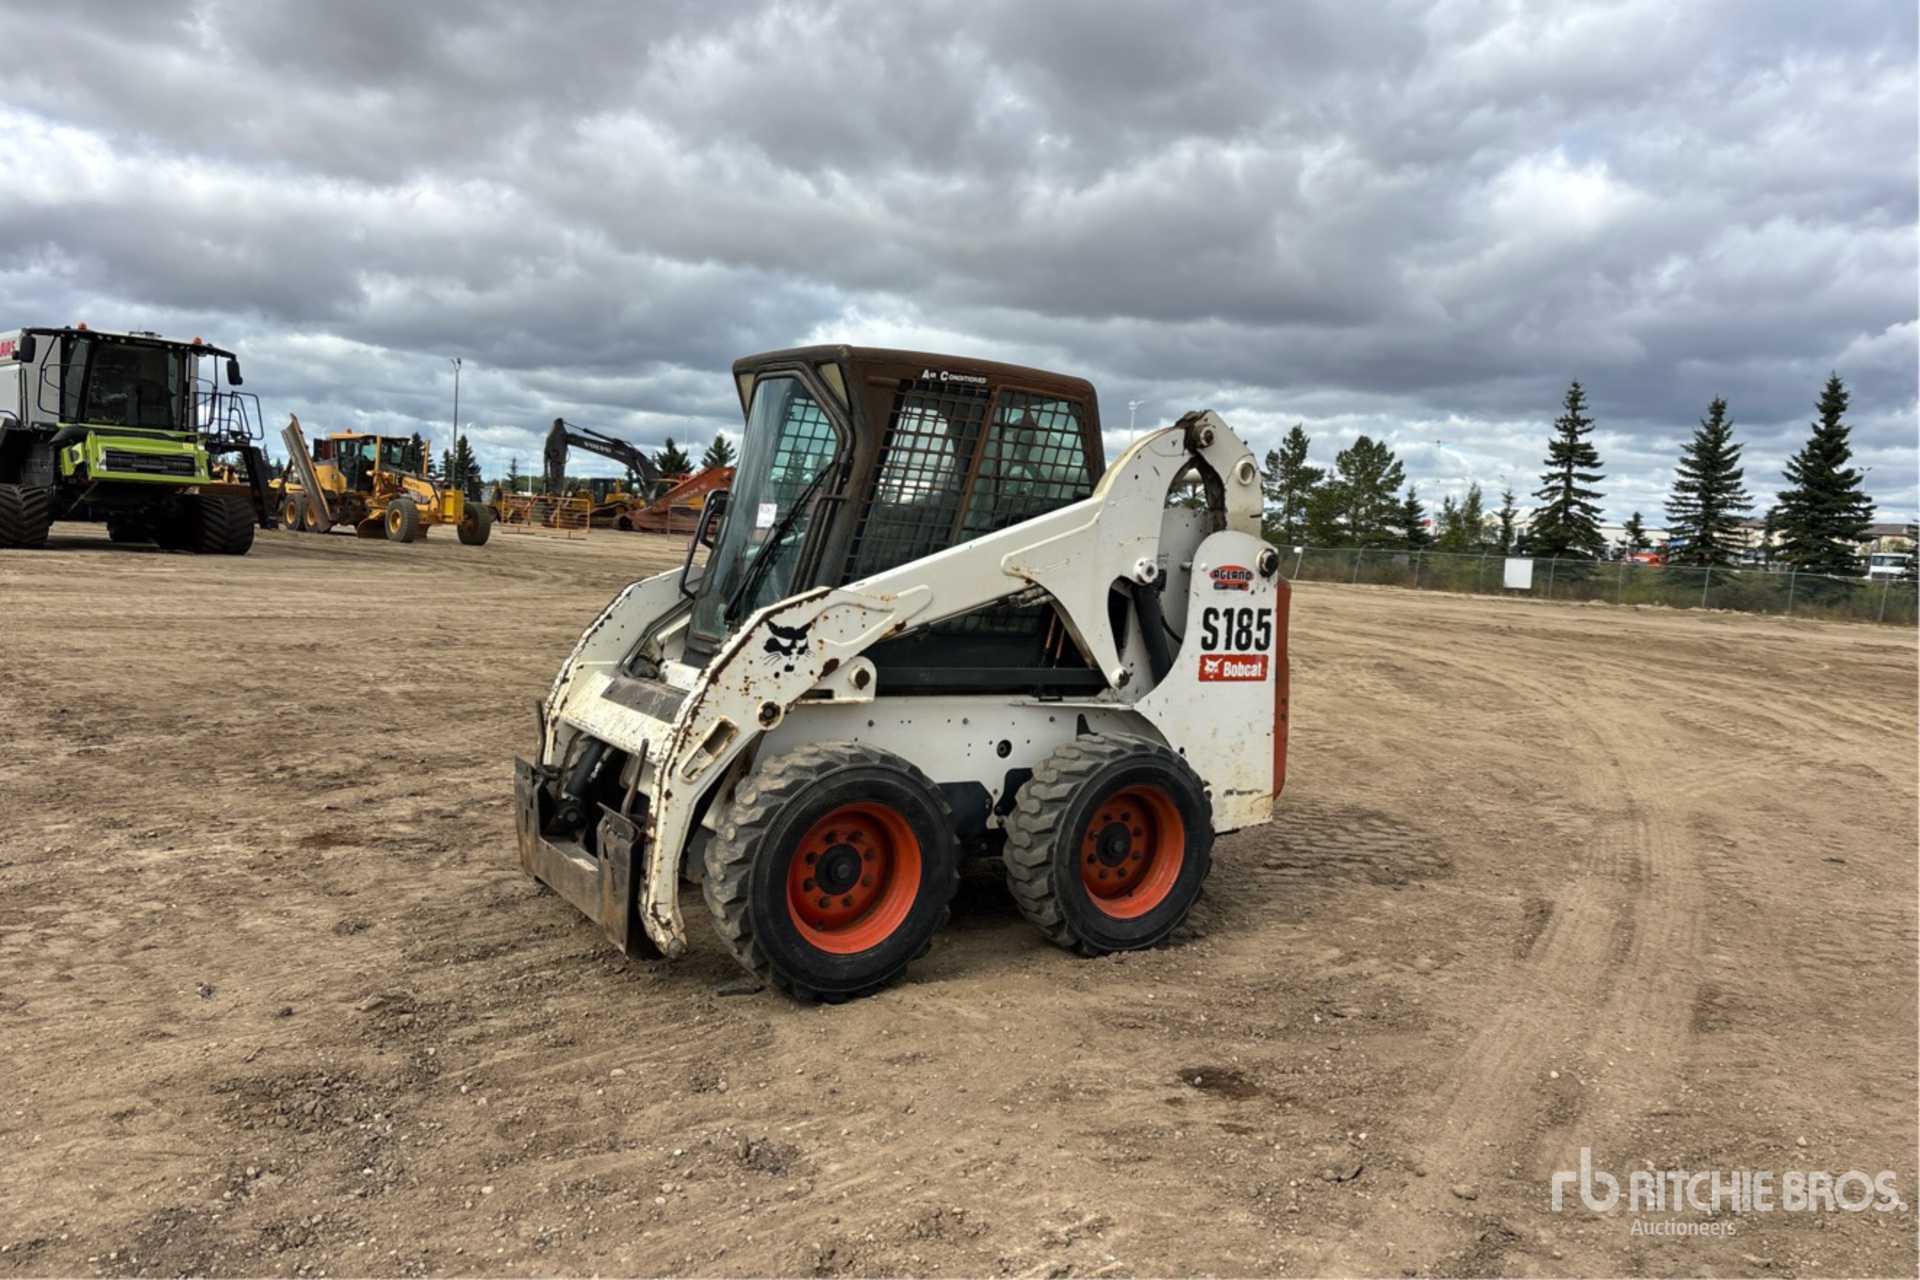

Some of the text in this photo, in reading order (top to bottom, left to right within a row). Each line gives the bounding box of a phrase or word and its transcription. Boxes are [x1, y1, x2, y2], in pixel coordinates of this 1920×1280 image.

[583, 440, 612, 453] VOLVO
[1213, 570, 1252, 580] AGLAND
[1201, 607, 1272, 651] S185
[1223, 661, 1263, 677] Bobcat
